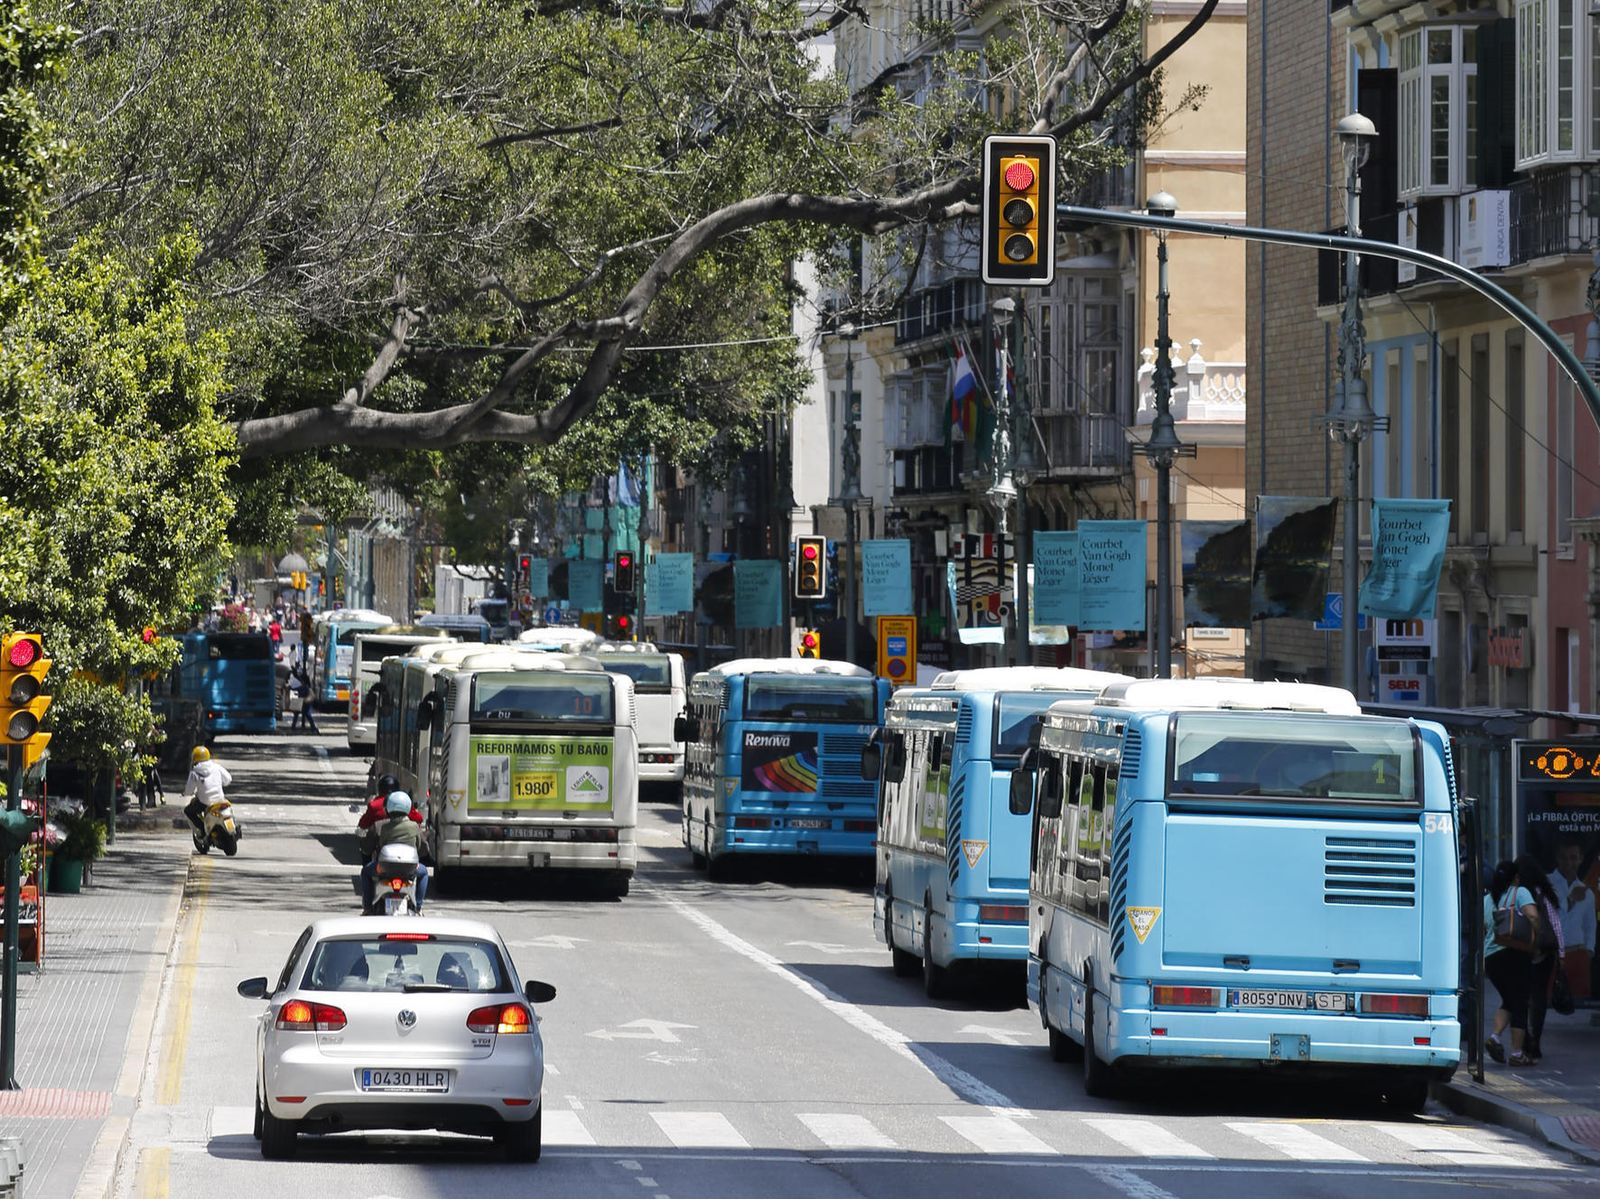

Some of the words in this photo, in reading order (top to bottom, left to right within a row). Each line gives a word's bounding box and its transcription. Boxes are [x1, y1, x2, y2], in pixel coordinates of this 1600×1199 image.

[1379, 518, 1423, 531] Courbet
[1082, 539, 1123, 549] Courbet
[1398, 532, 1431, 545] Gogh
[1037, 547, 1073, 556] Courbet
[1082, 551, 1102, 560] Van
[1104, 550, 1131, 562] Gogh
[1037, 558, 1055, 566] Van
[1083, 562, 1114, 572] Monet
[1037, 567, 1066, 576] Monet
[1388, 679, 1420, 690] SEUR
[745, 733, 790, 747] Renova
[477, 743, 556, 755] REFORMAMOS
[560, 744, 574, 755] TU
[577, 742, 608, 756] BAÑO
[1372, 759, 1386, 784] 1
[515, 782, 554, 796] 1.980€
[1528, 812, 1541, 822] ¡La
[1542, 813, 1569, 821] FIBRA
[1571, 811, 1600, 821] ÓPTIC
[1559, 824, 1579, 832] está
[1242, 992, 1275, 1005] 8059
[1279, 993, 1303, 1006] DNV
[1318, 994, 1343, 1010] SP
[373, 1072, 411, 1087] 0430
[416, 1072, 445, 1087] HLR
